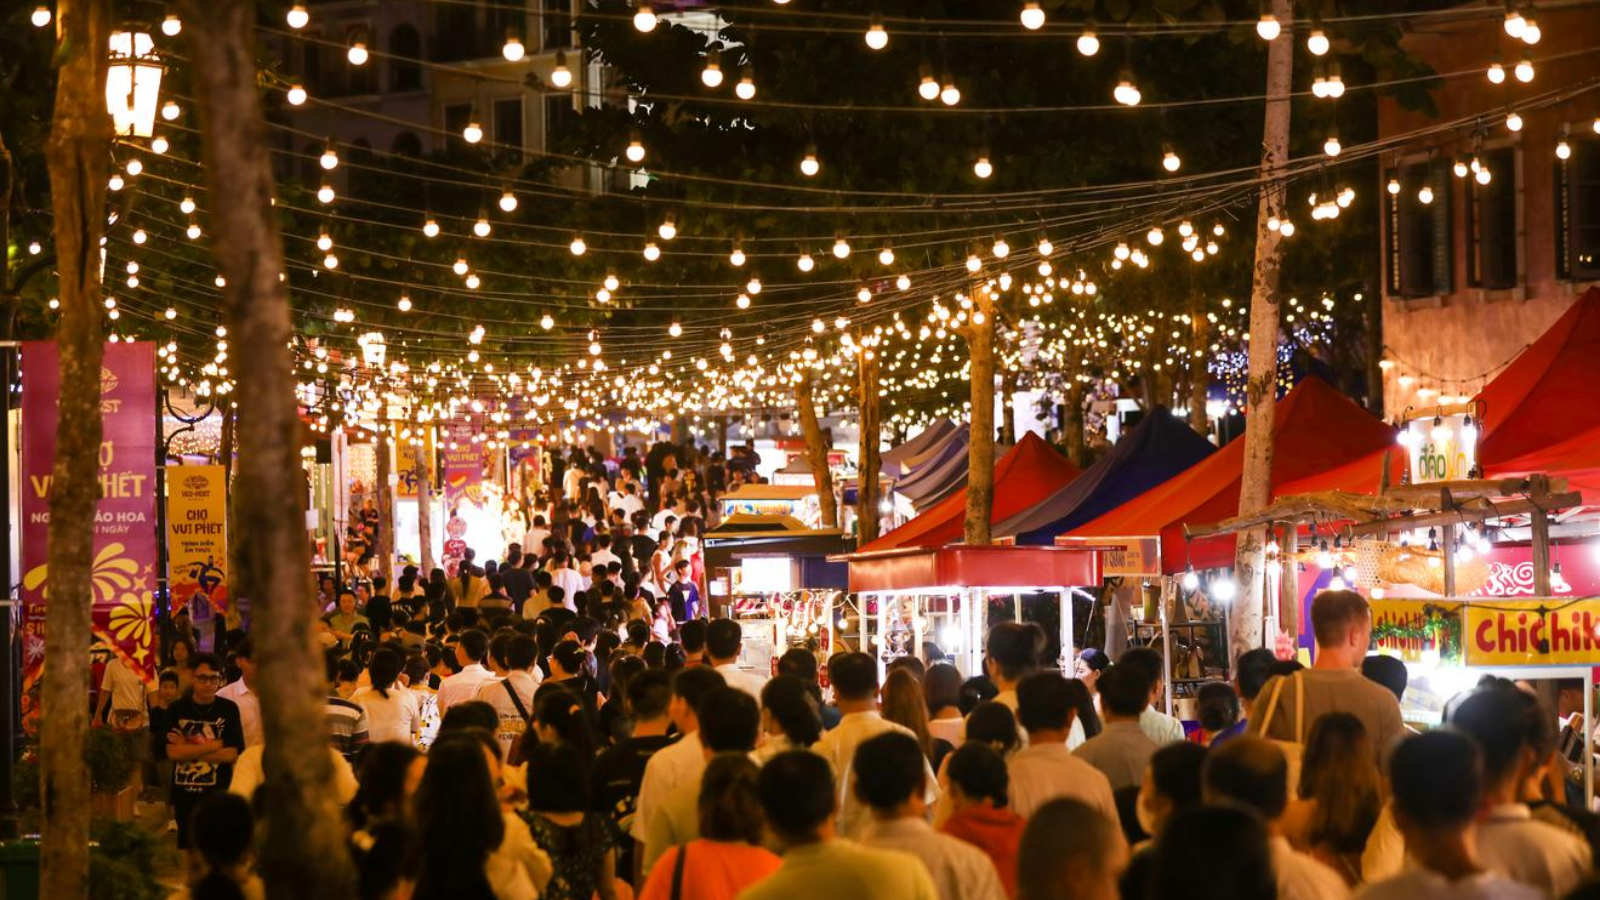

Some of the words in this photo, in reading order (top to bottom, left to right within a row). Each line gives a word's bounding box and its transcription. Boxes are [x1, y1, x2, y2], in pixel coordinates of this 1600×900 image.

[116, 511, 146, 522] HOA
[187, 509, 208, 521] CHỢ
[172, 524, 192, 534] VUI
